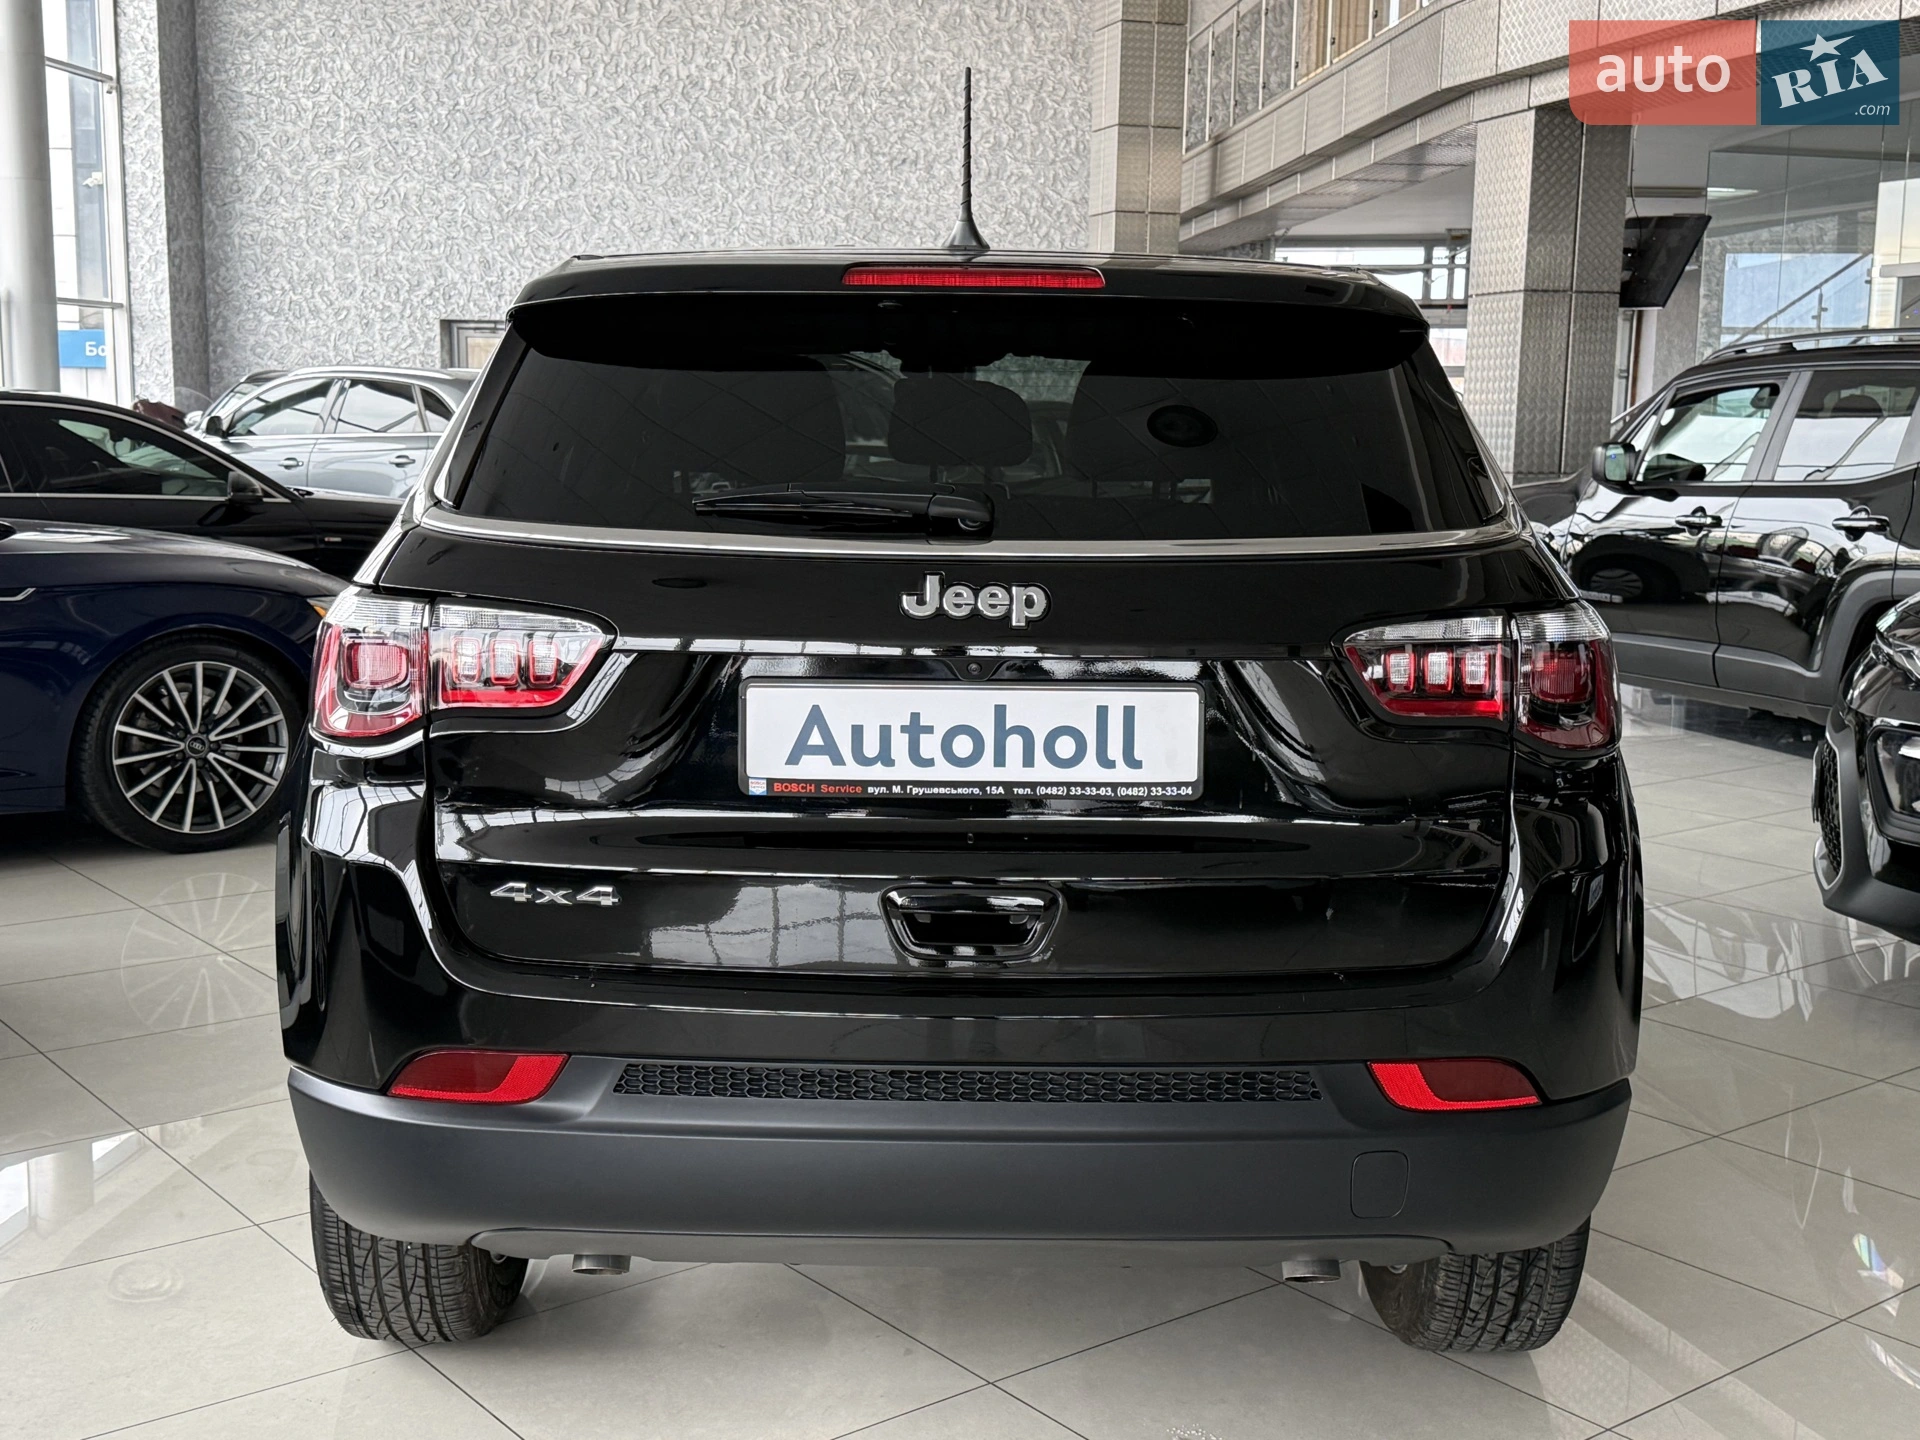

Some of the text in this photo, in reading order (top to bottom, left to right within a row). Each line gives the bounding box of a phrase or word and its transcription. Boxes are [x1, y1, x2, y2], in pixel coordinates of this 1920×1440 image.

[901, 573, 1049, 628] Jeep
[783, 703, 1144, 770] Autoholl
[773, 782, 815, 793] BOSCH
[820, 784, 863, 794] Service
[867, 786, 889, 795] вул.
[892, 785, 904, 794] М.
[906, 785, 982, 796] Грушевського,
[1013, 787, 1034, 795] тел.
[1036, 786, 1067, 796] (0482)
[1069, 786, 1115, 797] 33-33-03,
[1117, 786, 1148, 797] (0482)
[1150, 786, 1193, 796] 33-33-04
[489, 882, 620, 906] 4x4
